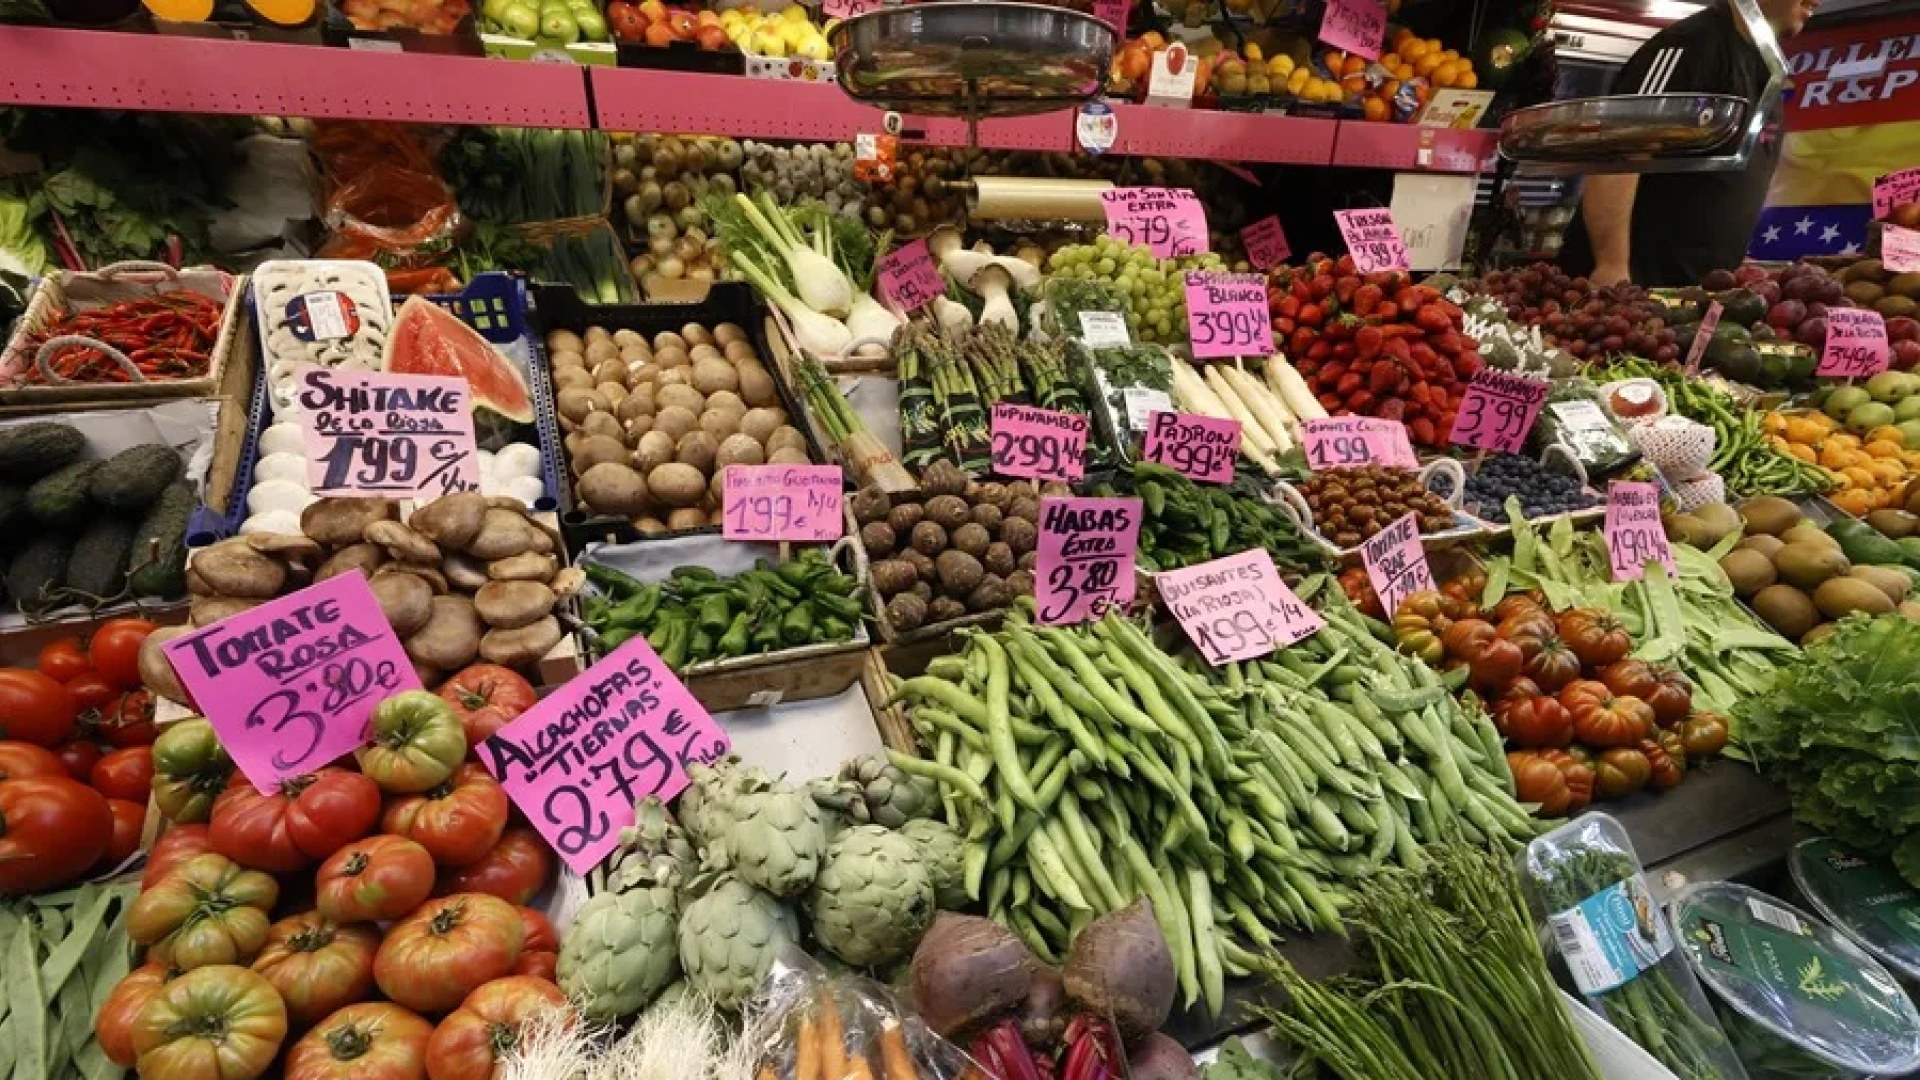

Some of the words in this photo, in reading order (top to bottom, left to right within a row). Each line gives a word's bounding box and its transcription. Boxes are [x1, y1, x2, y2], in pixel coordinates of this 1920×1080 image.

[1799, 70, 1919, 108] R&P
[301, 371, 462, 414] SHITAKE
[1457, 395, 1528, 439] 3'99
[992, 431, 1060, 475] 2'99
[1310, 436, 1371, 465] 1'99
[726, 495, 793, 535] 1'99
[1043, 503, 1131, 534] HABAS
[1157, 562, 1264, 602] GUISANTES
[172, 598, 342, 679] TOMATE
[255, 623, 374, 680] ROSA
[374, 659, 402, 691] €
[485, 658, 653, 783] ALCACHOFAS
[661, 708, 692, 737] €
